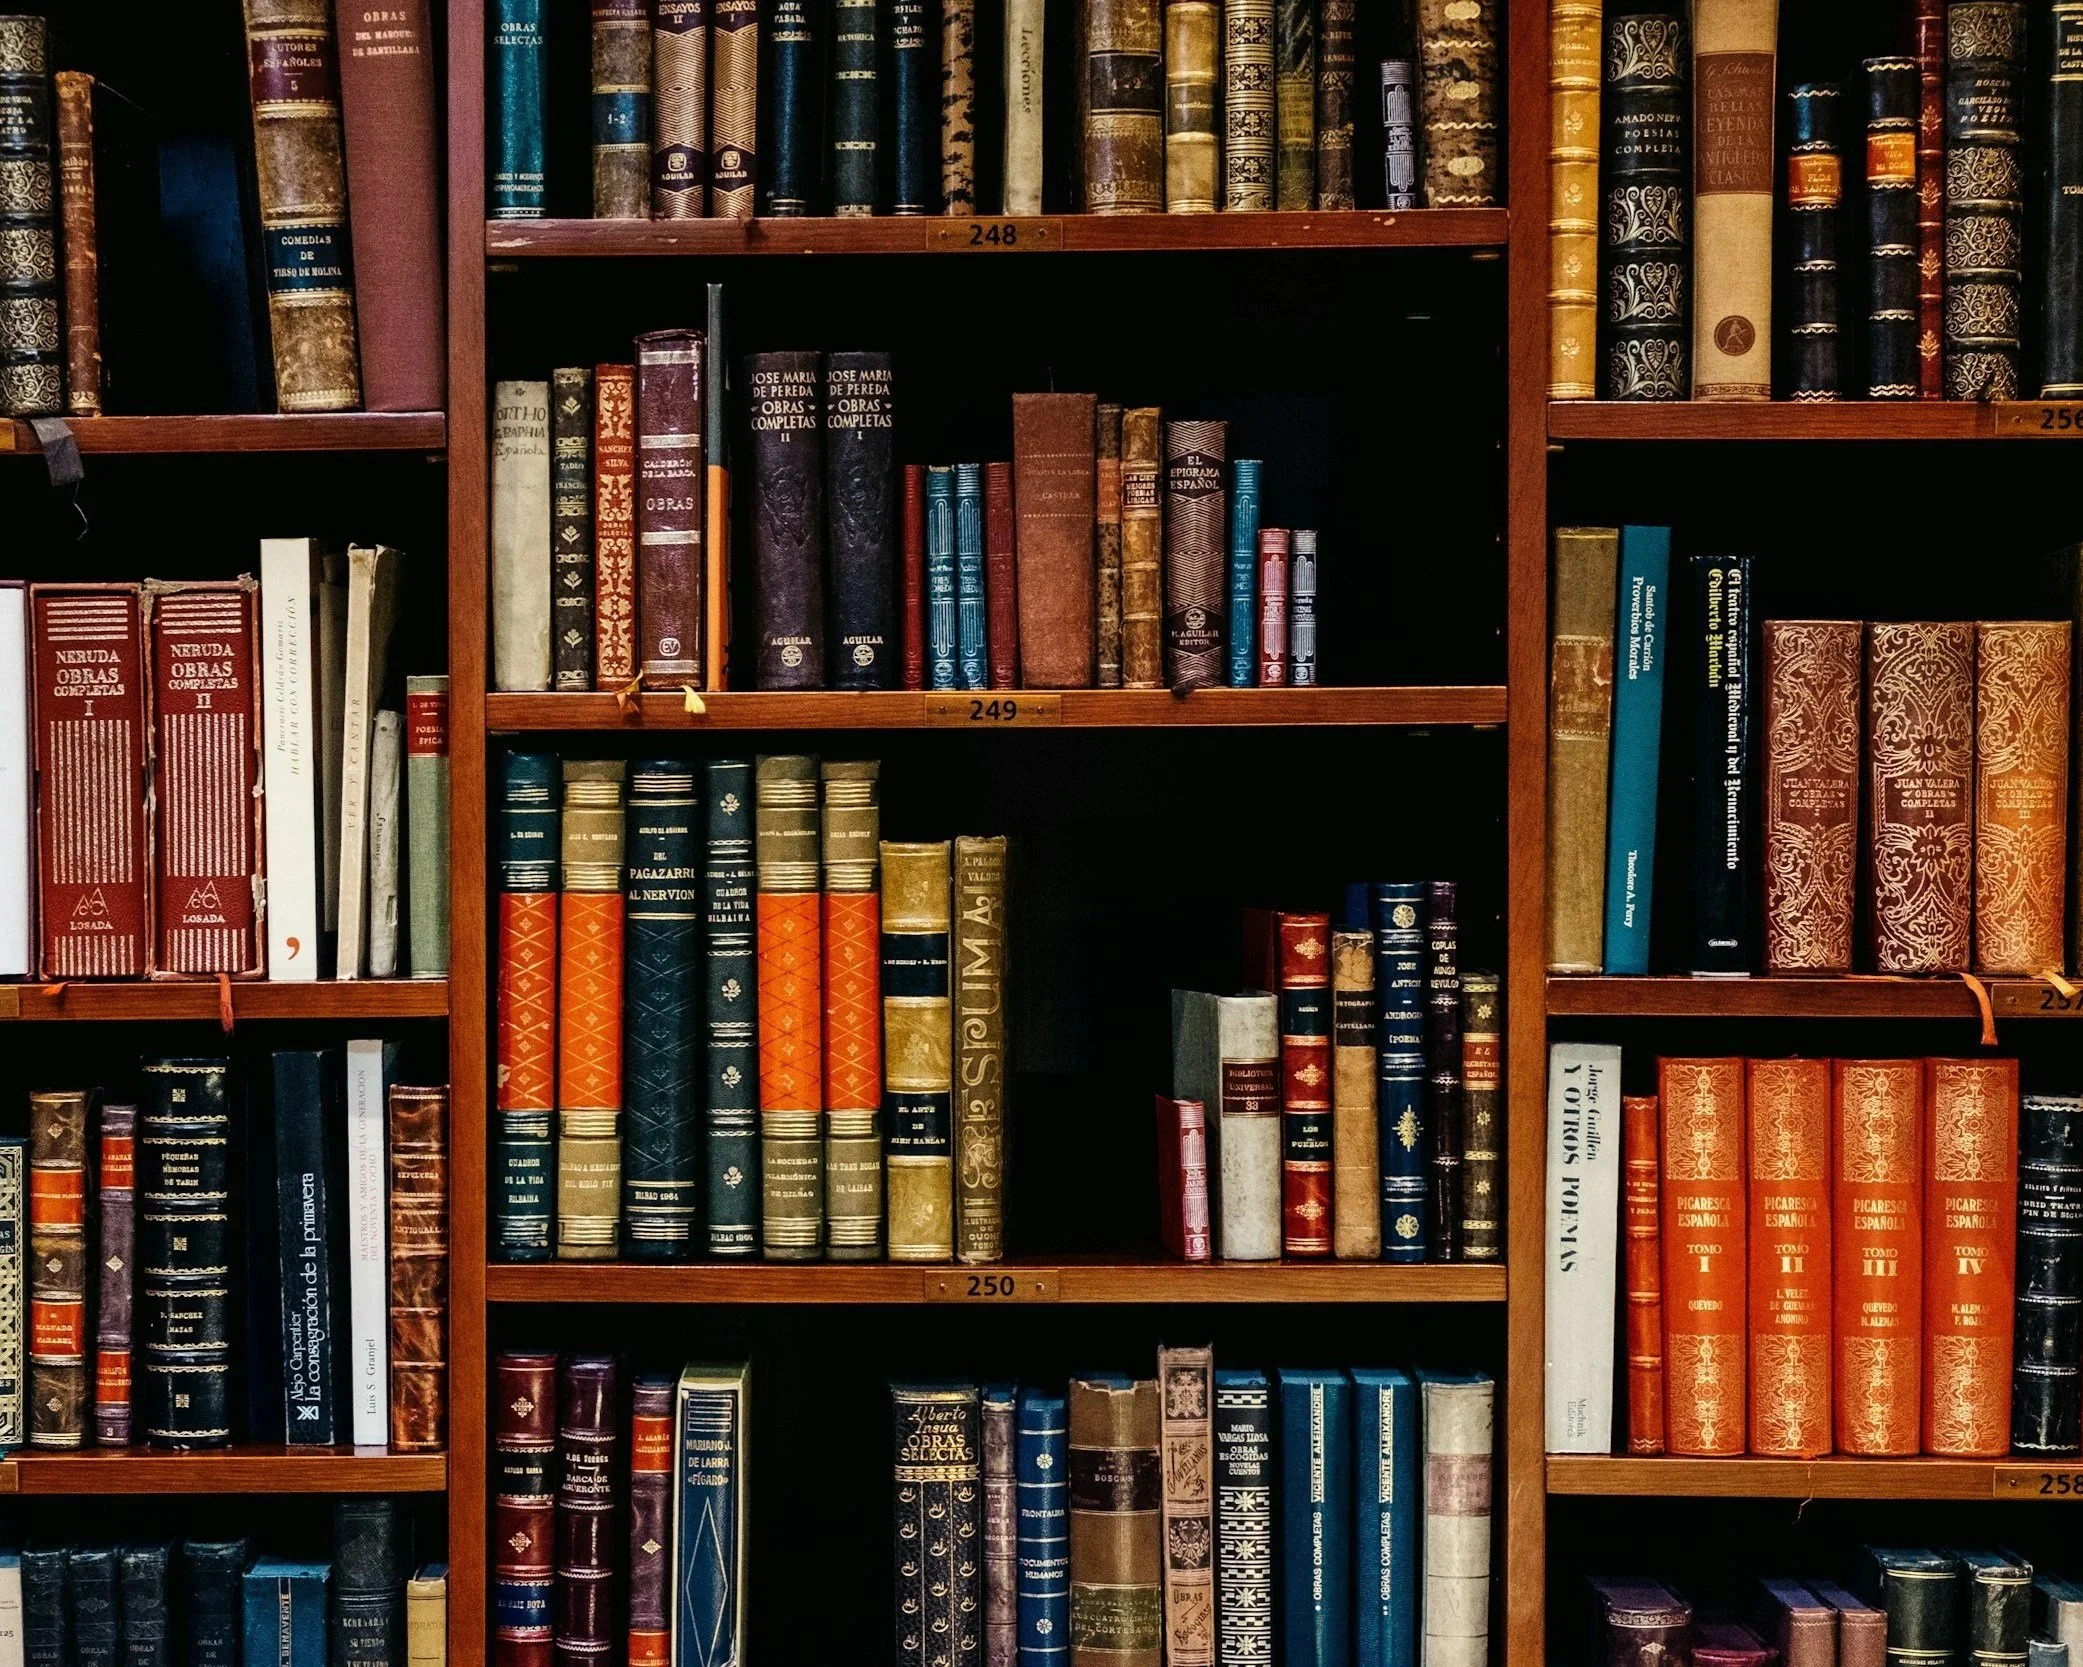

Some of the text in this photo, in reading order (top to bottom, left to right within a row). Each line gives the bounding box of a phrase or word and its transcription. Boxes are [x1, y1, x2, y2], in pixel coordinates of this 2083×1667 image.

[658, 3, 701, 16] ENSAYOS
[715, 1, 756, 14] ENSAYOS
[363, 11, 406, 22] OBRAS
[501, 22, 536, 32] OBRAS
[494, 36, 544, 46] SELECTAS
[1615, 114, 1654, 124] AMADO
[281, 234, 332, 246] COMEDIAS
[969, 224, 1017, 246] 248
[300, 251, 315, 261] DE
[750, 372, 816, 384] JOSE MARIA
[826, 370, 892, 382] JOSE MARIA
[753, 386, 814, 398] DE PEREDA
[830, 383, 890, 396] DE PEREDA
[762, 401, 804, 414] OBRAS
[838, 398, 880, 412] OBRAS
[750, 416, 816, 430] COMPLETAS
[828, 414, 892, 428] COMPLETAS
[780, 432, 791, 442] II
[1188, 456, 1202, 466] EL
[1170, 468, 1220, 478] EPIGRAMA
[1170, 477, 1220, 490] ESPAÑOL
[646, 497, 694, 511] OBRAS
[1728, 568, 1742, 585] El
[1728, 588, 1740, 626] teatro
[1628, 576, 1644, 680] Proverbios Morales
[1642, 585, 1656, 672] Santob de Carrión
[771, 636, 812, 646] AGUILAR
[842, 636, 884, 645] AGUILAR
[56, 650, 121, 664] NERUDA
[170, 644, 234, 658] NERUDA
[1725, 630, 1740, 678] español
[56, 668, 119, 684] OBRAS
[171, 662, 233, 678] OBRAS
[54, 684, 124, 696] COMPLETAS
[168, 678, 238, 690] COMPLETAS
[287, 596, 300, 776] HABLAR CON CORRECCIÓN
[84, 700, 94, 716] I
[196, 693, 212, 709] II
[969, 700, 1018, 721] 249
[350, 698, 360, 764] CANTAR
[1727, 757, 1740, 775] del
[1894, 778, 1960, 789] JUAN VALERA
[1804, 790, 1836, 798] OBRAS
[1916, 790, 1946, 798] OBRAS
[1900, 799, 1956, 808] COMPLETAS
[1724, 778, 1741, 870] Renacimiento
[630, 868, 695, 880] PAGAZARRI
[628, 888, 695, 900] AL NERVION
[1624, 850, 1638, 928] Theodore A. Perry
[70, 920, 113, 930] LOSADA
[182, 913, 225, 924] LOSADA
[1432, 941, 1456, 950] COPLAS
[1439, 954, 1449, 963] DE
[1434, 966, 1456, 976] MINGO
[1430, 980, 1459, 988] REVULGO
[1246, 1100, 1258, 1110] 33
[1585, 1064, 1603, 1160] Jorge Guillén
[358, 1070, 369, 1262] MAESTROS GENERACION
[1560, 1064, 1582, 1273] Y OTROS POEMAS
[1677, 1196, 1731, 1211] PICARESCA
[1764, 1196, 1816, 1210] PICARESCA
[1854, 1199, 1907, 1214] PICARESCA
[1946, 1198, 2000, 1212] PICARESCA
[370, 1196, 378, 1242] NOVENTA
[1678, 1213, 1730, 1228] ESPAÑOLA
[1766, 1213, 1816, 1228] ESPAÑOLA
[1855, 1216, 1906, 1230] ESPAÑOLA
[1946, 1215, 1998, 1228] ESPAÑOLA
[1686, 1244, 1722, 1254] TOMO
[1774, 1244, 1810, 1254] TOMO
[1862, 1248, 1898, 1258] TOMO
[1954, 1246, 1988, 1256] TOMO
[1700, 1256, 1710, 1272] I
[1780, 1256, 1804, 1272] II
[1862, 1260, 1898, 1276] III
[1958, 1258, 1986, 1275] IV
[300, 1172, 325, 1402] La consagración de la primavera
[966, 1275, 1015, 1296] 250
[1688, 1300, 1722, 1310] QUEVEDO
[1862, 1302, 1898, 1313] QUEVEDO
[289, 1312, 307, 1402] Alejo Carpentier
[366, 1338, 378, 1414] Luis Granjel
[908, 1405, 966, 1421] Alberto
[915, 1420, 959, 1434] Insua
[1230, 1424, 1254, 1432] MARIO
[686, 1439, 724, 1450] MARIANO
[908, 1434, 966, 1448] OBRAS
[1218, 1433, 1269, 1442] VARGAS LLOSA
[1312, 1386, 1322, 1502] VICENTE ALEIXANDRE
[1230, 1446, 1258, 1454] OBRAS
[1381, 1388, 1391, 1502] VICENTE ALEIXANDRE
[688, 1456, 730, 1468] DE LARRA
[900, 1448, 974, 1462] SELECTAS
[566, 1474, 593, 1484] BARCA
[1228, 1468, 1260, 1476] CUENTOS
[1312, 1511, 1322, 1600] OBRAS COMPLETAS
[1380, 1511, 1391, 1600] OBRAS COMPLETAS
[1026, 1570, 1064, 1580] HUMANOS
[281, 1593, 290, 1657] BENAVENTE
